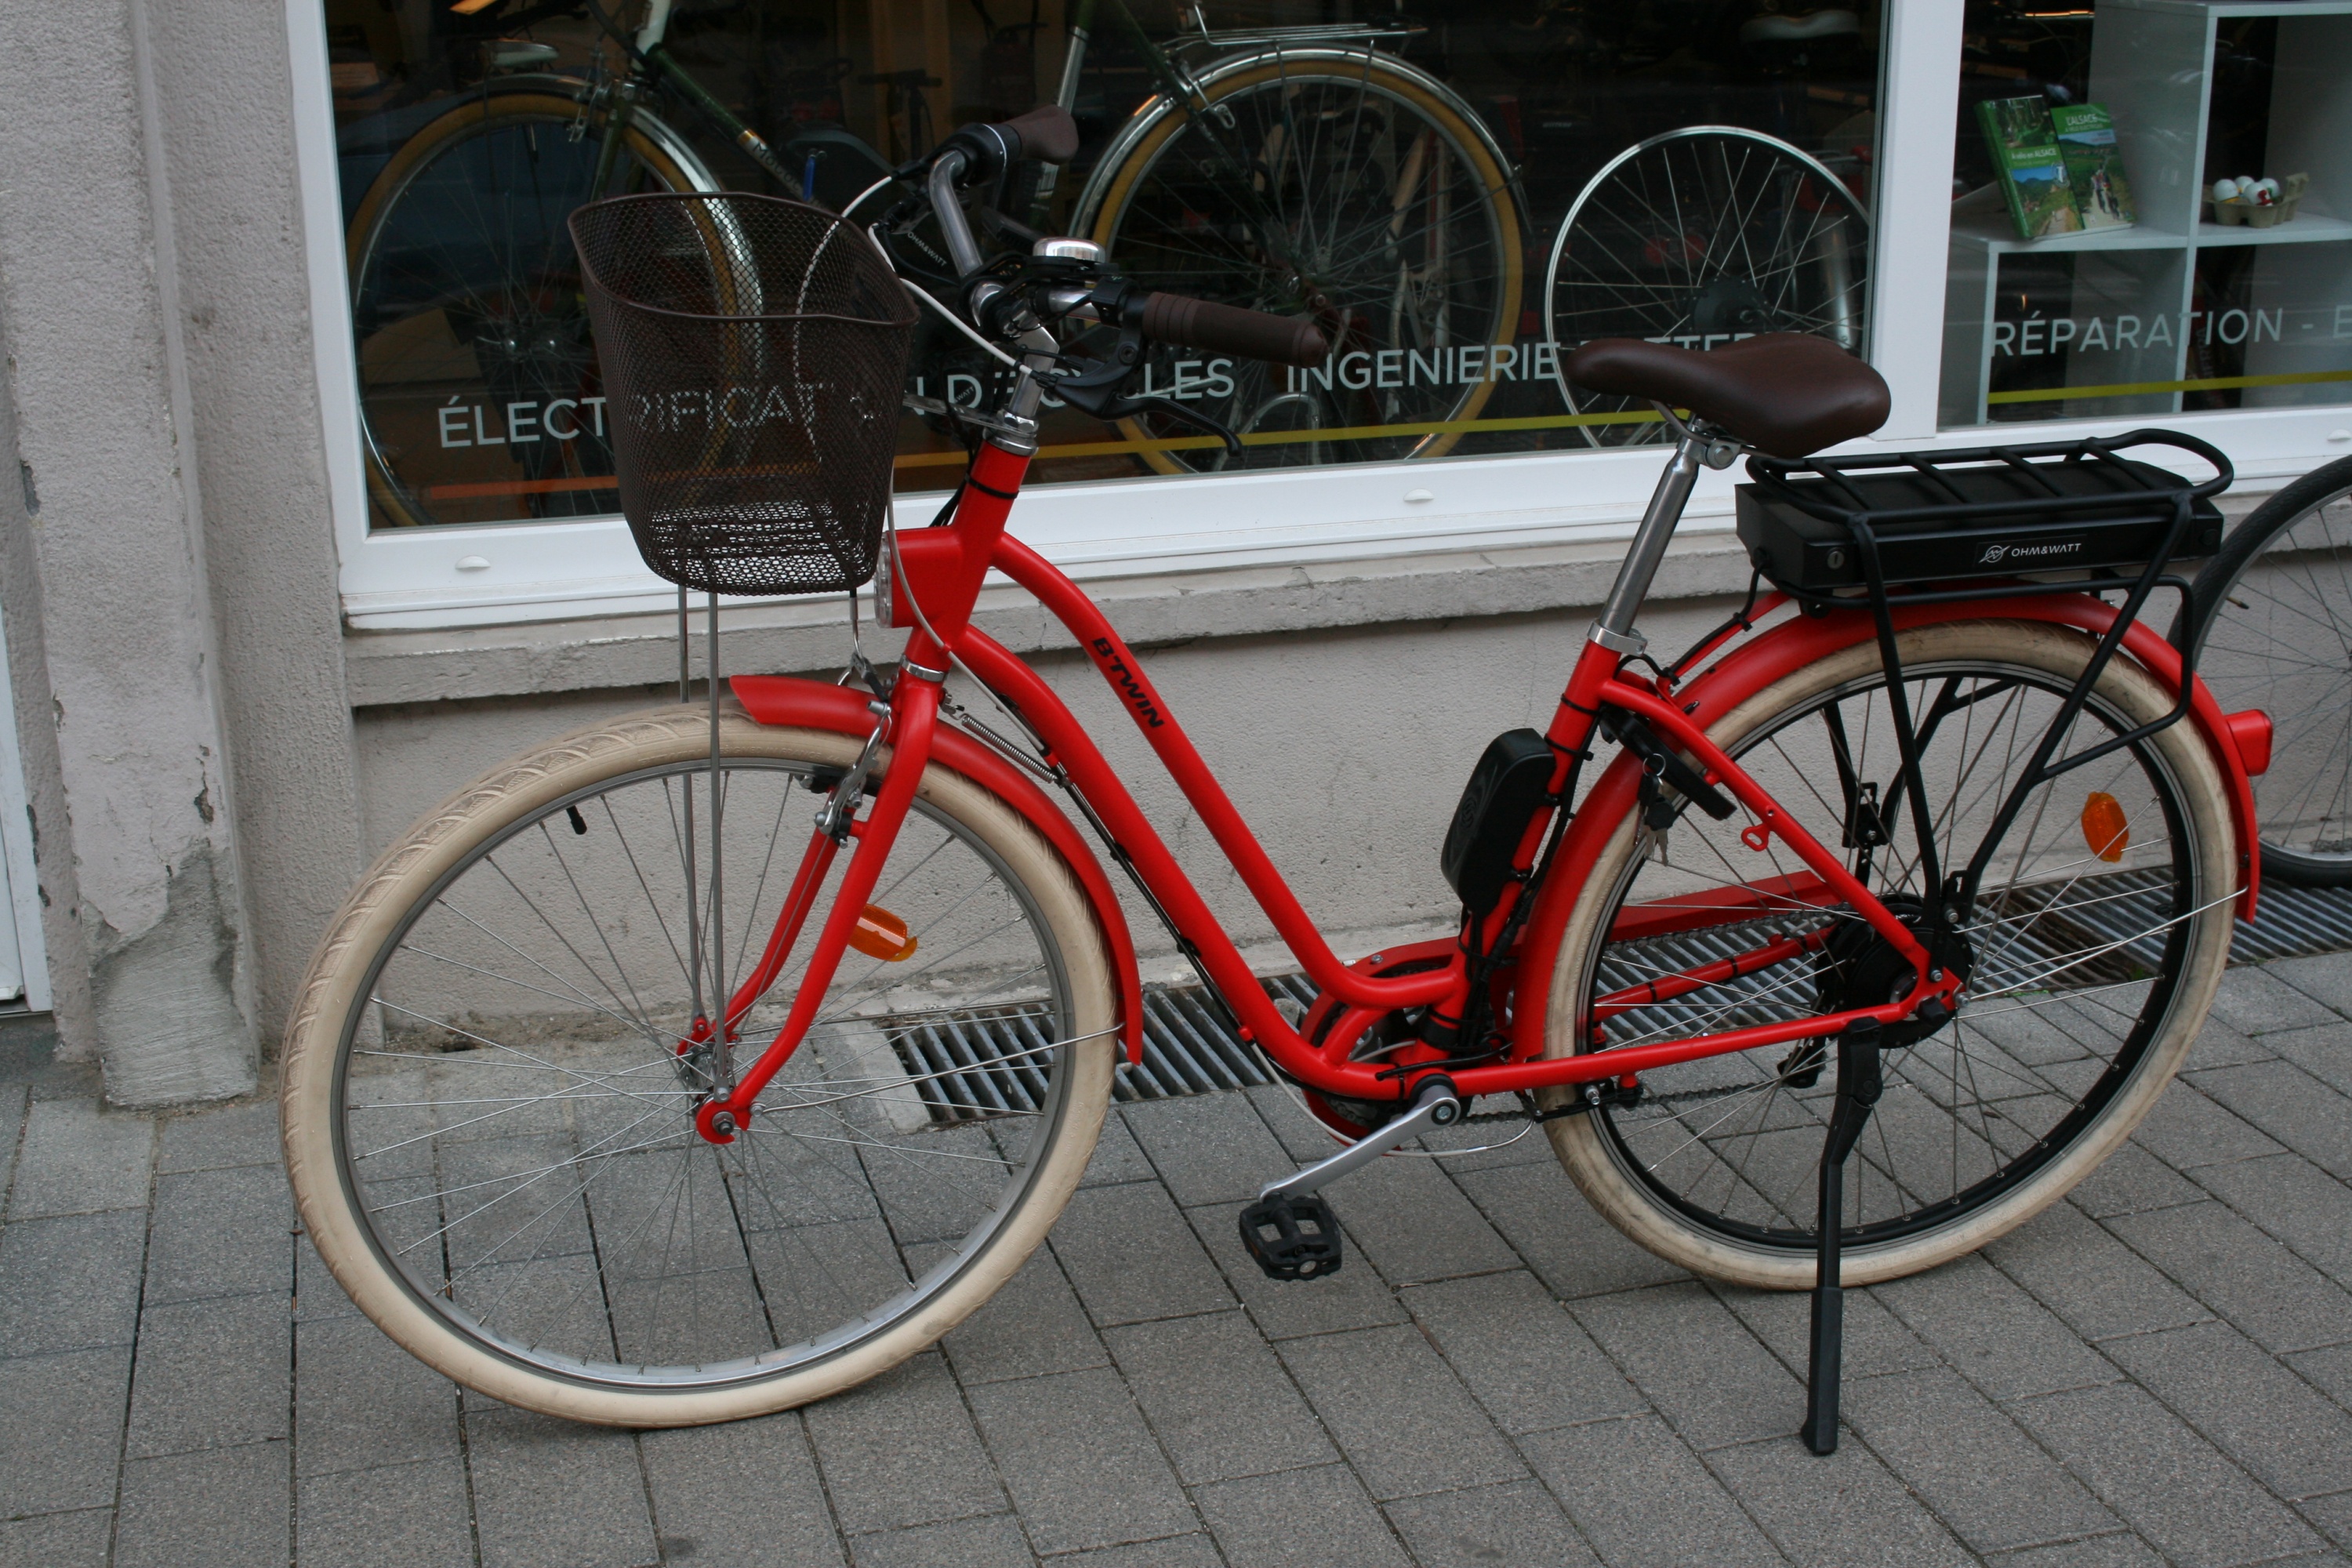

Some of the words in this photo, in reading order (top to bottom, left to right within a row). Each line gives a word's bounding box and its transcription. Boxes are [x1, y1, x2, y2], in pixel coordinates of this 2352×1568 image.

[1991, 307, 2283, 357] RÉPARATION
[1287, 341, 1561, 392] INGENIERIE
[2011, 543, 2082, 557] OHM&WATT
[1091, 637, 1165, 728] B'TWIN
